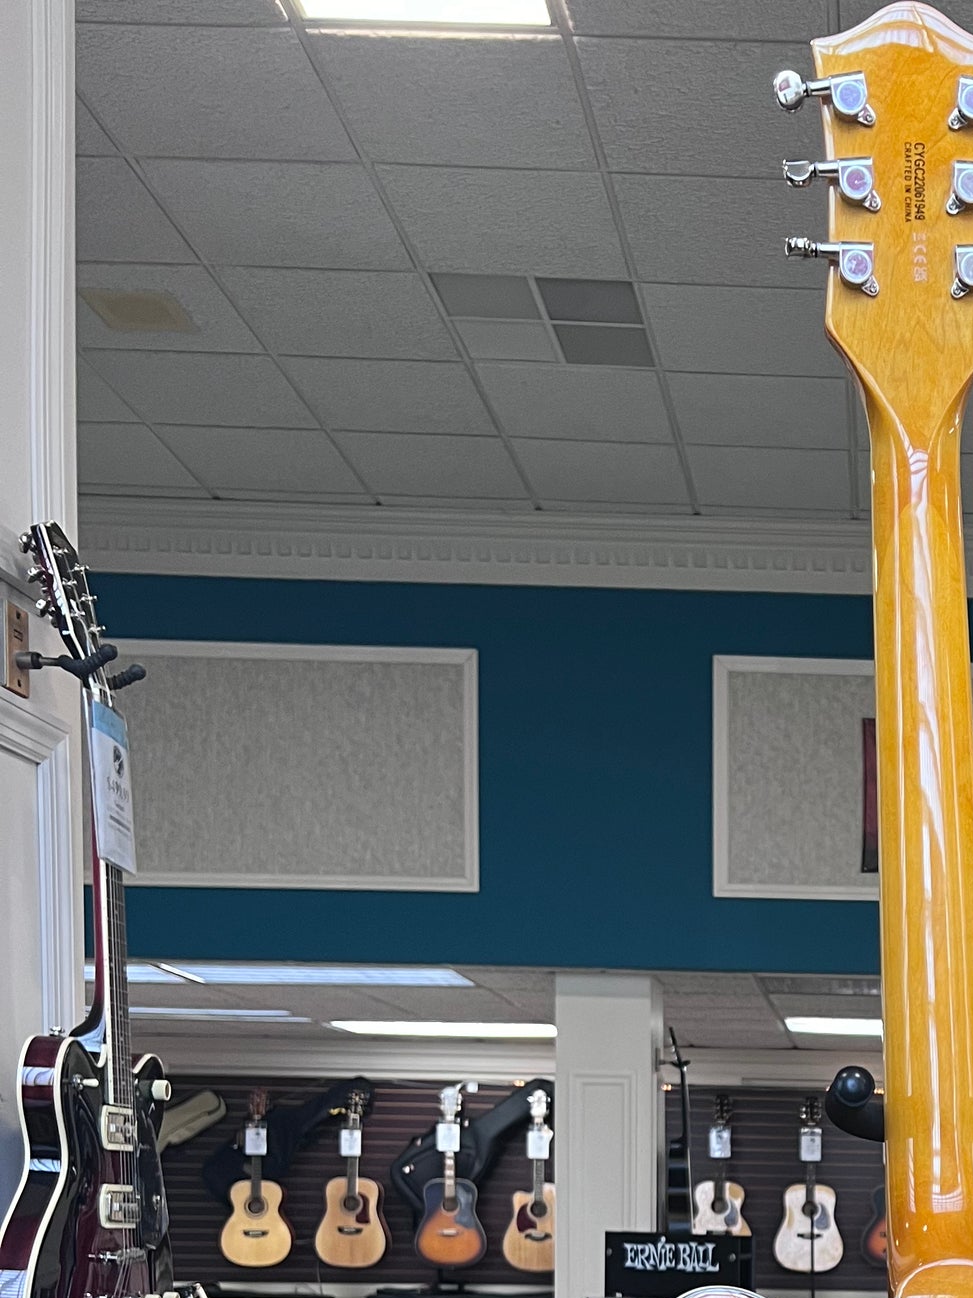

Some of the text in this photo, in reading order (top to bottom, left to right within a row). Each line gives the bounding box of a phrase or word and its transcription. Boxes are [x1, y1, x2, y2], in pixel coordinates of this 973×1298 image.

[904, 141, 912, 223] CRAFTED IN CHINA
[914, 142, 926, 221] CYGC22061949
[676, 1241, 720, 1272] BALL
